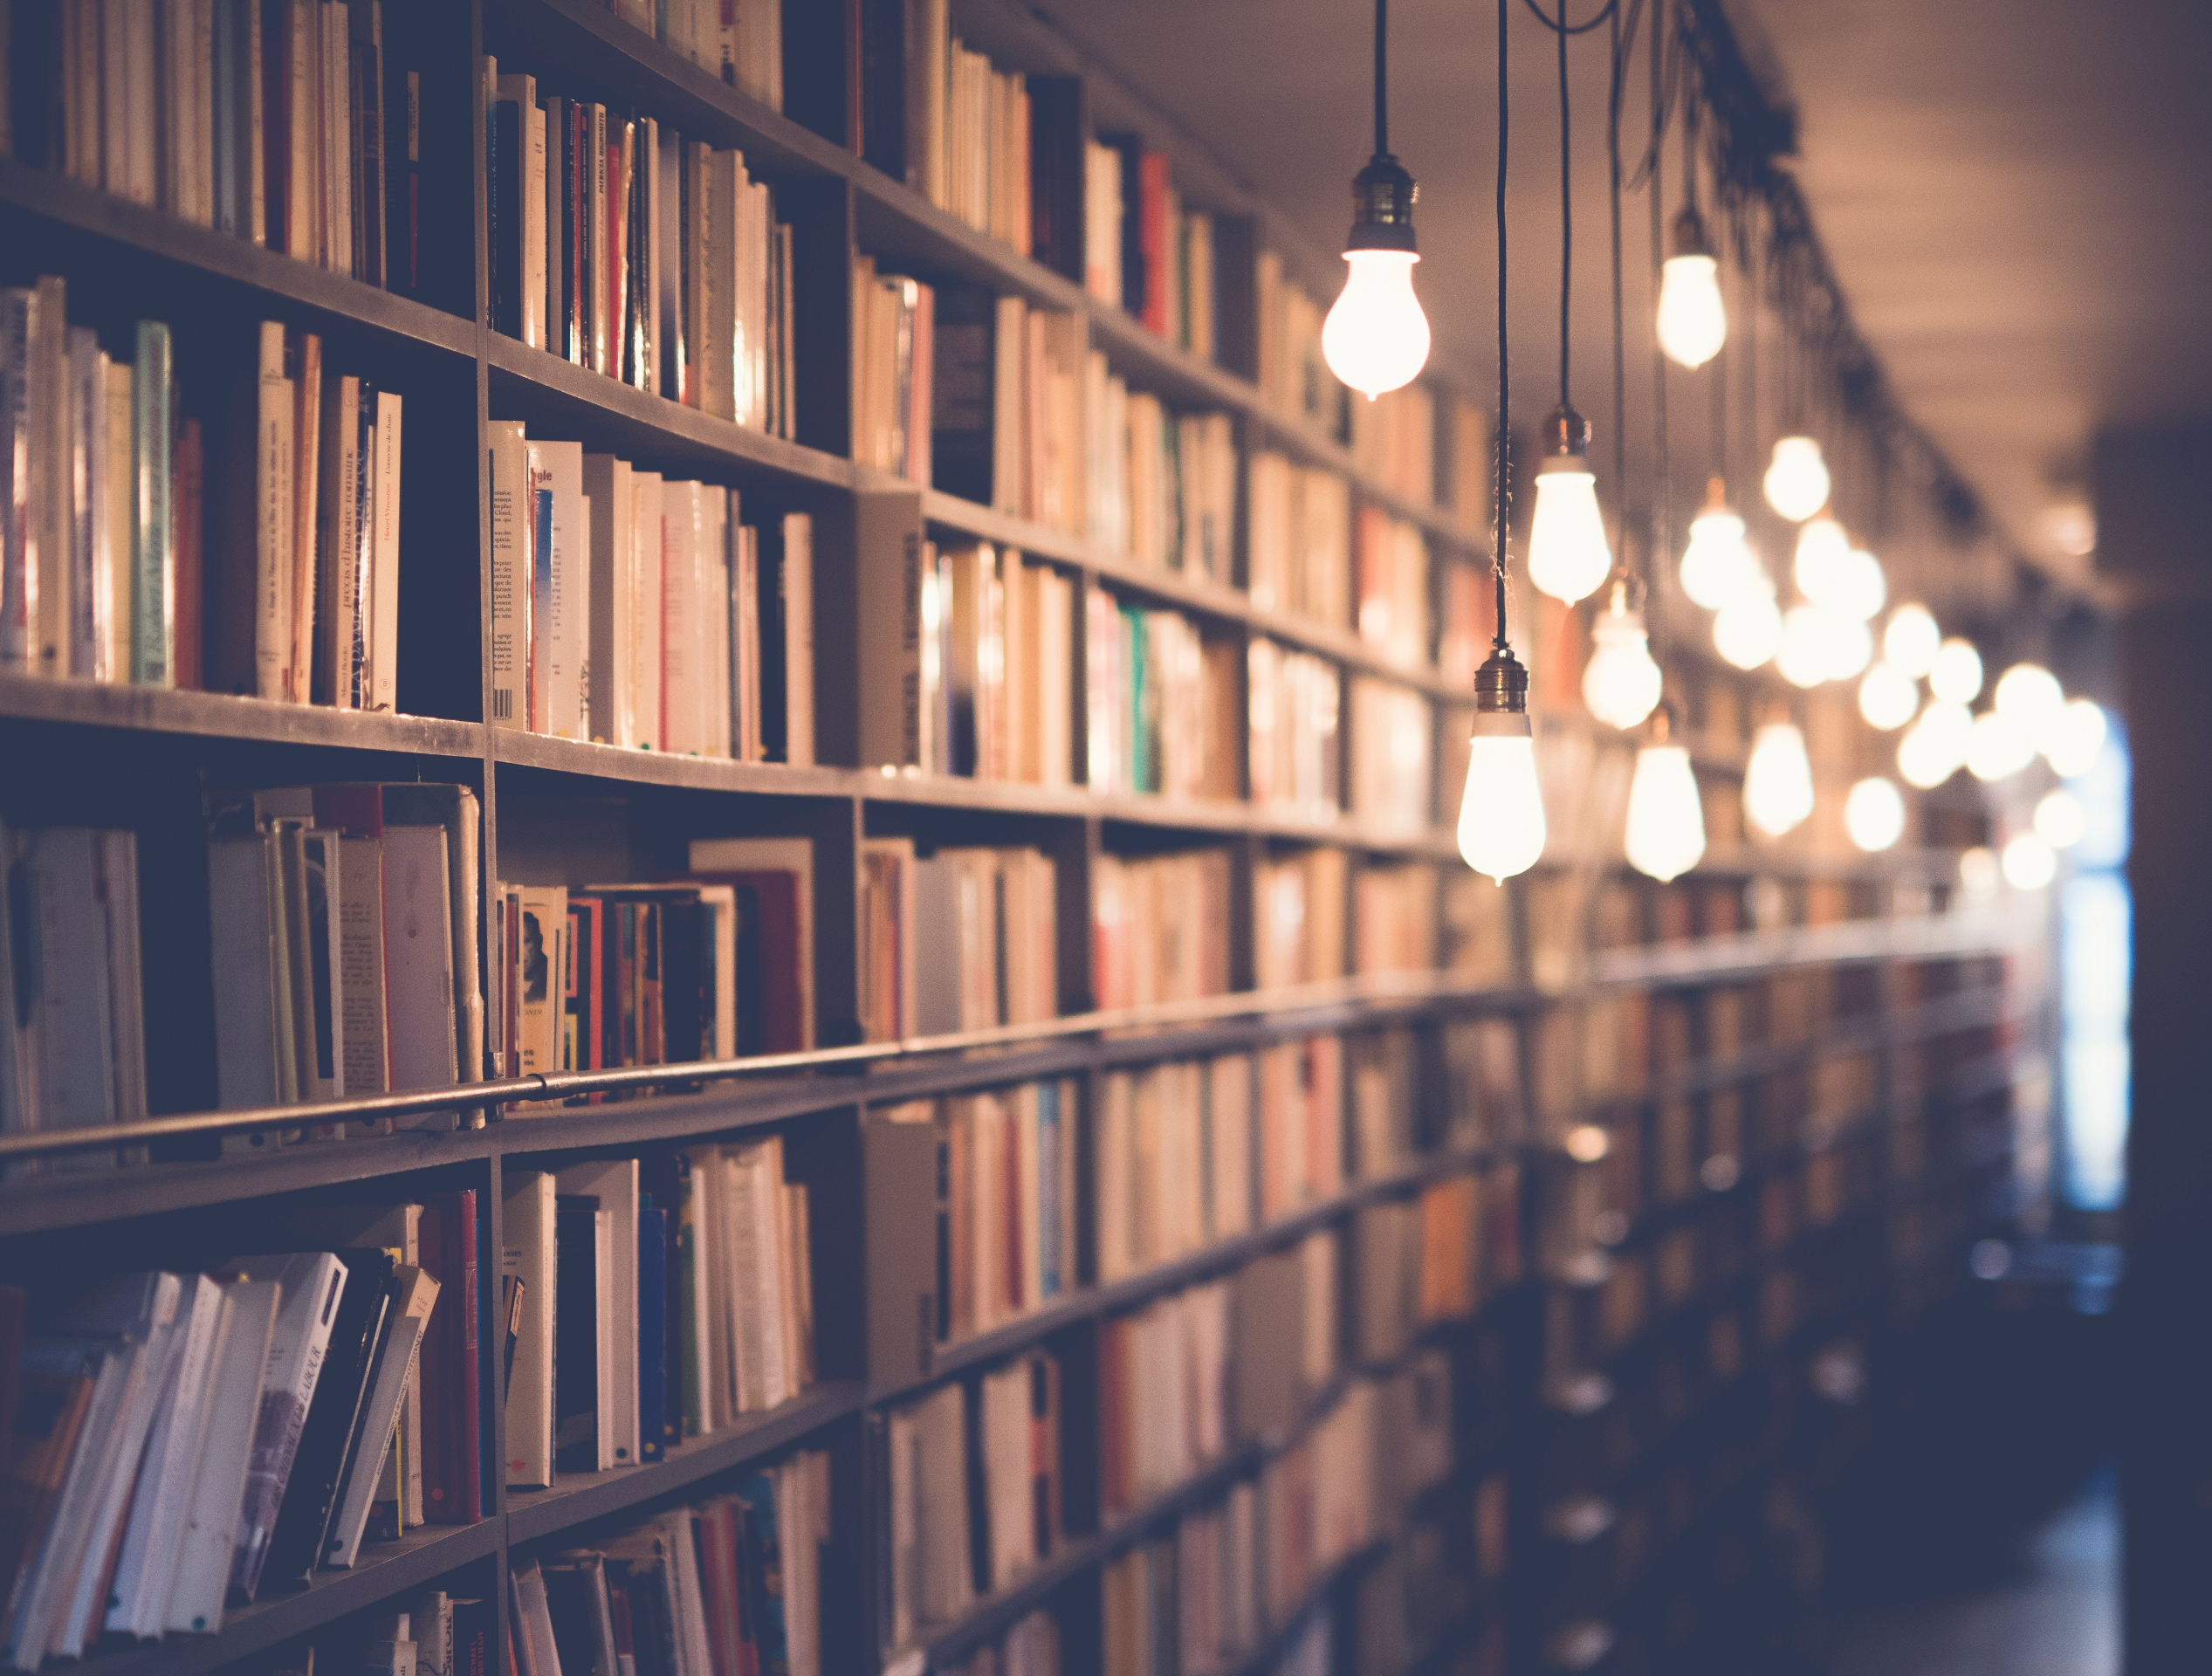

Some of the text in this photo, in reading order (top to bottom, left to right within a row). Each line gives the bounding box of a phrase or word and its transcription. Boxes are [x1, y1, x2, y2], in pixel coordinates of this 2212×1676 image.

[537, 469, 552, 483] gle
[341, 449, 353, 608] précis d'histoire romaine
[300, 1345, 320, 1401] LABOUR
[406, 1329, 424, 1375] DONATELLO
